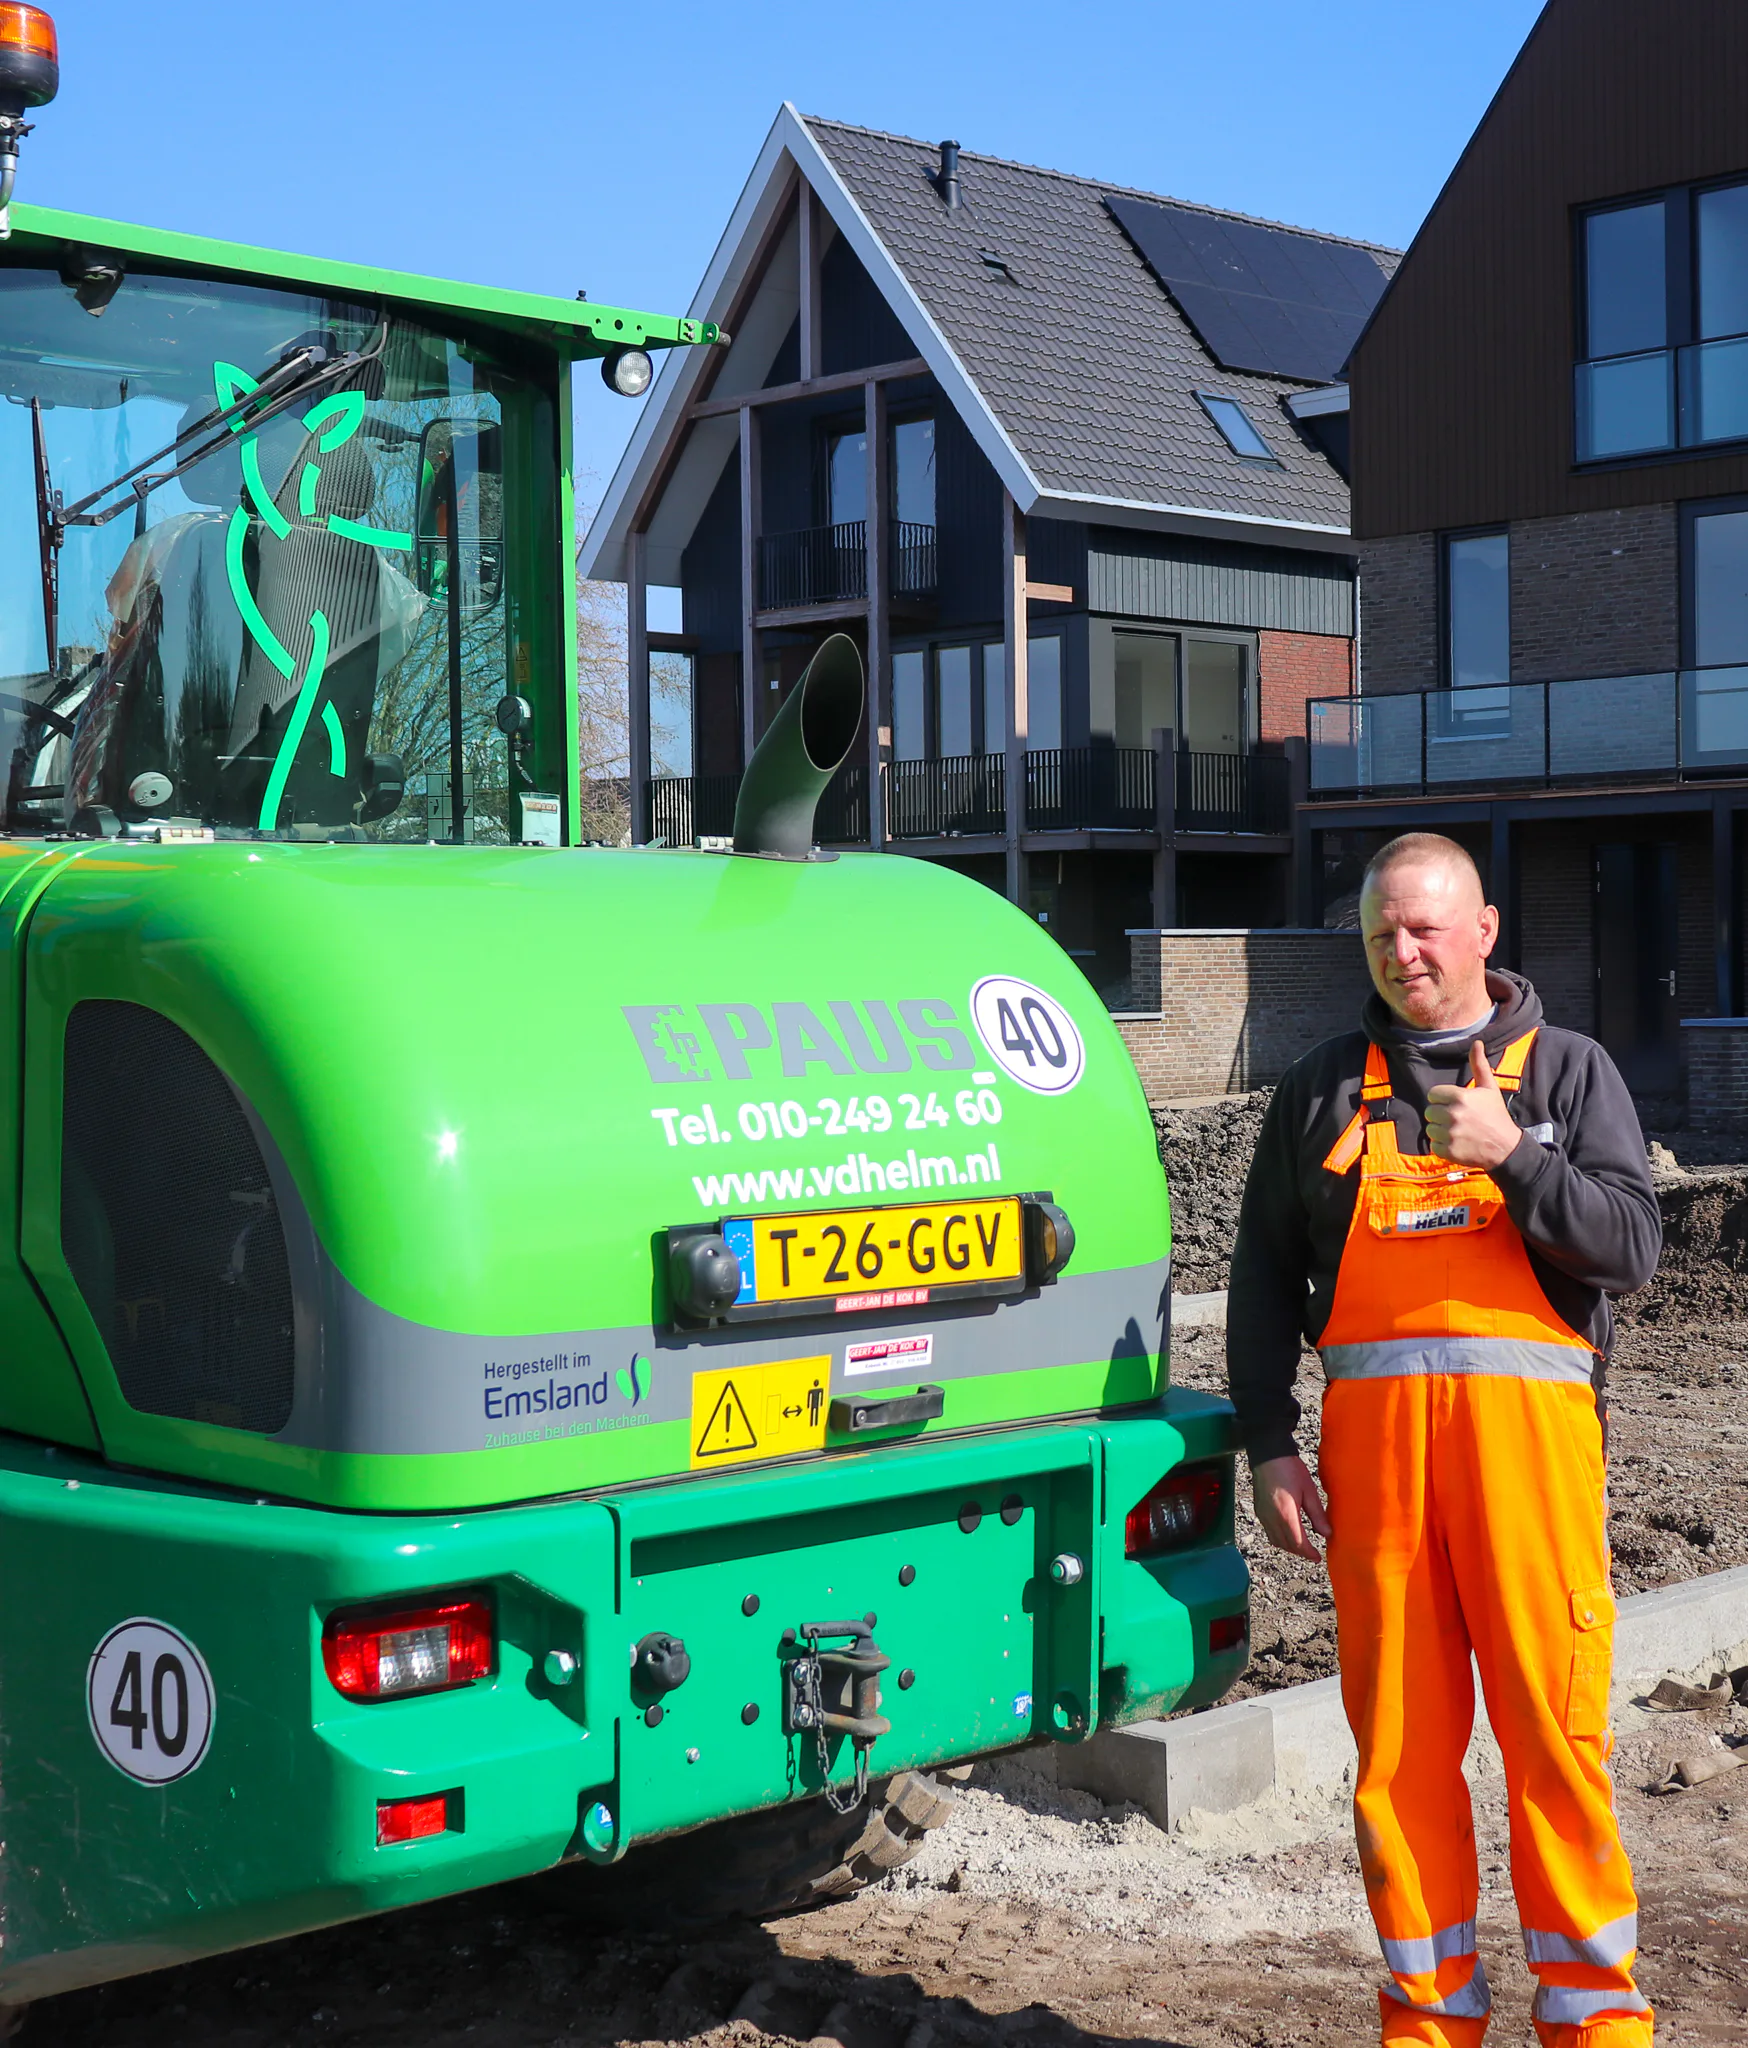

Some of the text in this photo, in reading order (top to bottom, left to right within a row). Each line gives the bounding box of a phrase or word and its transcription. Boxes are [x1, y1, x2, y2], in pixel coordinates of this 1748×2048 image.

[696, 999, 976, 1079] PAUS
[995, 996, 1068, 1069] 40
[650, 1089, 1003, 1146] Tel. 010-249 24 60
[692, 1142, 1002, 1207] www.vdhelm.nl
[1415, 1213, 1465, 1230] HELM
[769, 1212, 1002, 1288] T-26-GGV
[836, 1289, 929, 1310] GEERT-JAN DE KOK BV
[484, 1352, 591, 1380] Hergestellt im
[849, 1344, 887, 1358] GEERT-JAN
[887, 1342, 899, 1353] DE
[484, 1371, 608, 1419] Emsland
[484, 1413, 653, 1449] Zuhause bei den Machern.
[110, 1650, 189, 1758] 40
